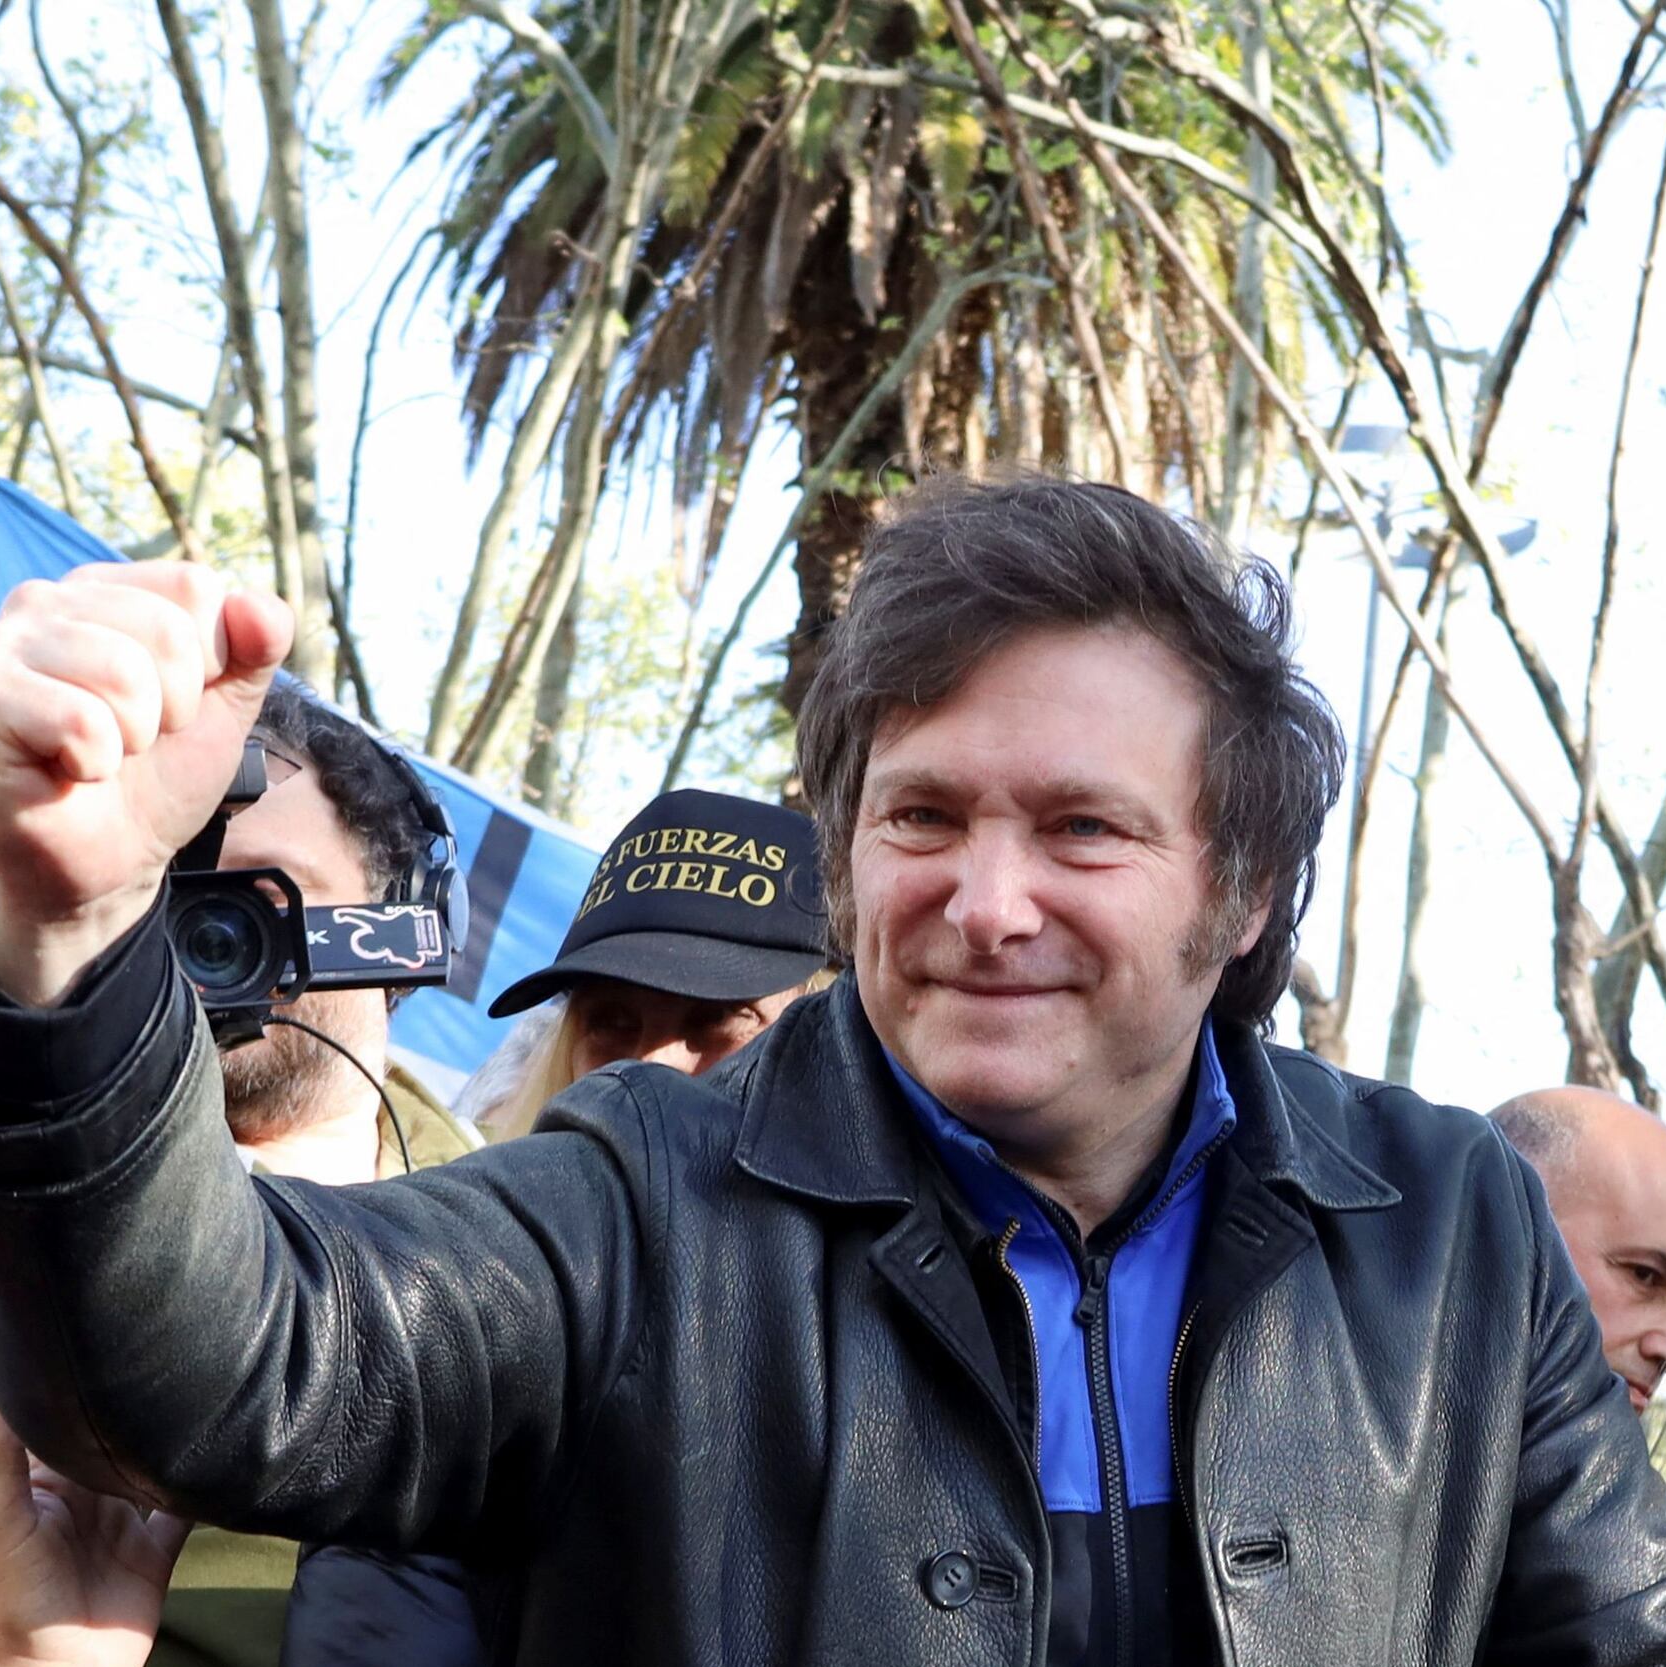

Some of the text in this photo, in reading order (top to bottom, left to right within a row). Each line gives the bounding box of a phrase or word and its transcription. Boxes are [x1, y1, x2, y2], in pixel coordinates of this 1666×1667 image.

[615, 828, 786, 872] FUERZAS
[577, 861, 776, 922] EL CIELO
